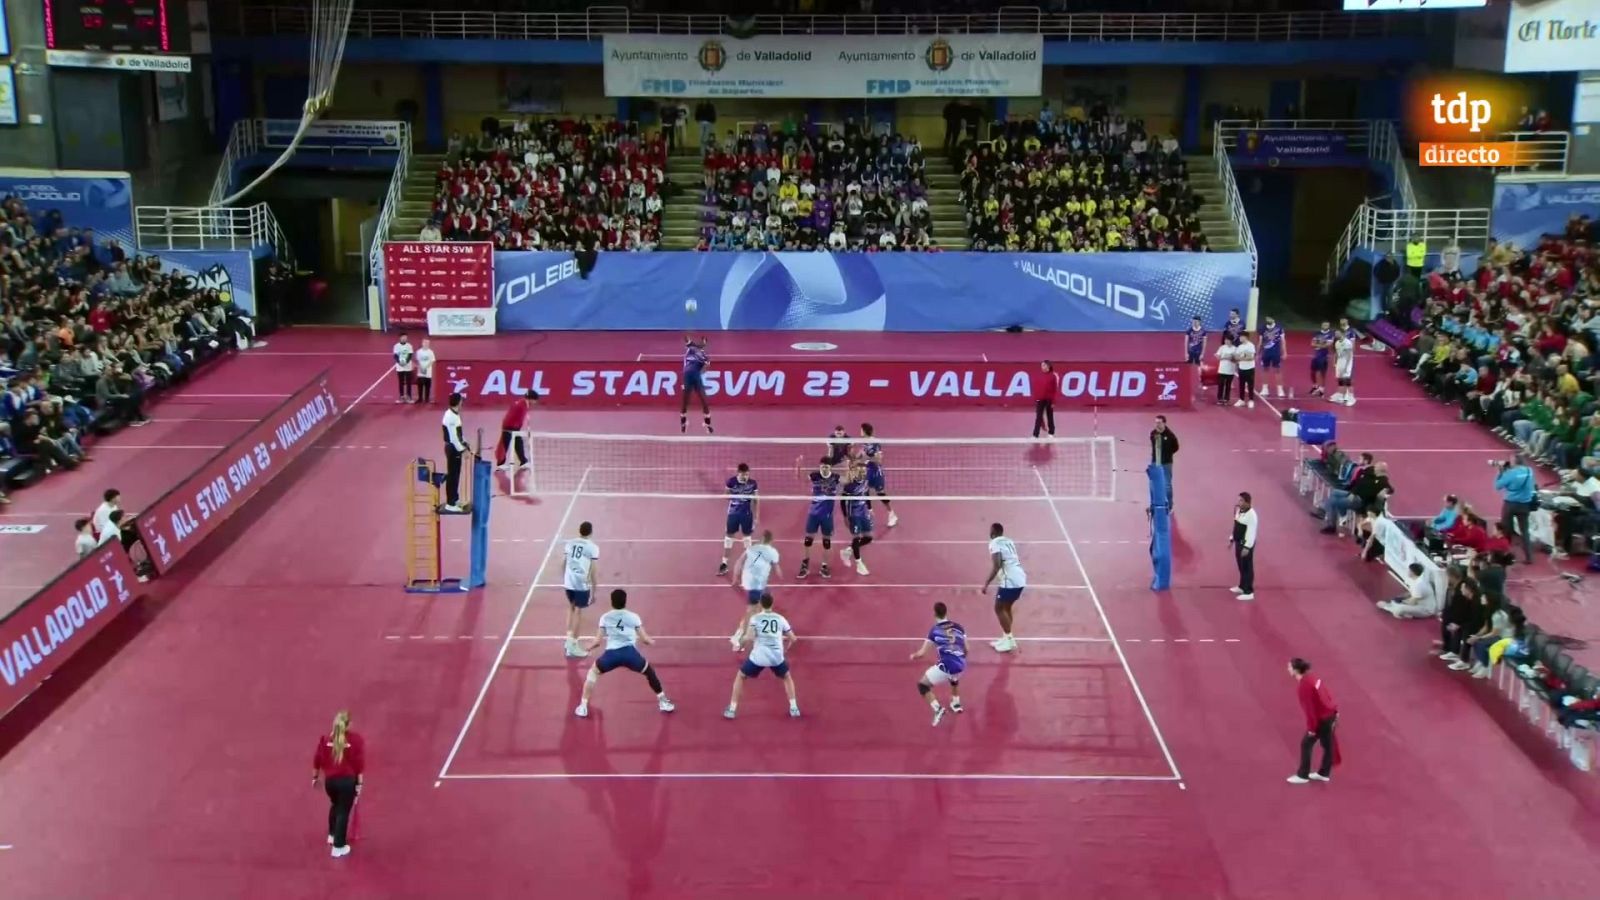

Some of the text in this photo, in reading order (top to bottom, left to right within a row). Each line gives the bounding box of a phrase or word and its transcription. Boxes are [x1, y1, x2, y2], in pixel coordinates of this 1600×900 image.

[1518, 19, 1598, 42] El Norte
[129, 58, 190, 70] de Valladolid
[611, 50, 812, 63] Ayuntamiento de Valladolid
[838, 50, 1037, 63] Ayuntamiento de Valladolid
[866, 79, 912, 94] FMD
[402, 244, 474, 254] ALL STAR SVM
[1020, 260, 1146, 319] VALLADOLID
[480, 369, 550, 396] ALL
[570, 370, 678, 396] STAR
[701, 370, 785, 397] SVM
[803, 371, 851, 397] 23
[909, 370, 1147, 397] VALLAOLID
[171, 504, 199, 542] ALL
[196, 475, 231, 520] STAR
[228, 454, 258, 492] SVM
[253, 442, 272, 470] 23
[275, 394, 328, 451] VALLADOLID
[571, 544, 584, 559] 18
[0, 577, 109, 685] VALLADOLID
[615, 618, 625, 632] 4
[761, 619, 778, 634] 20
